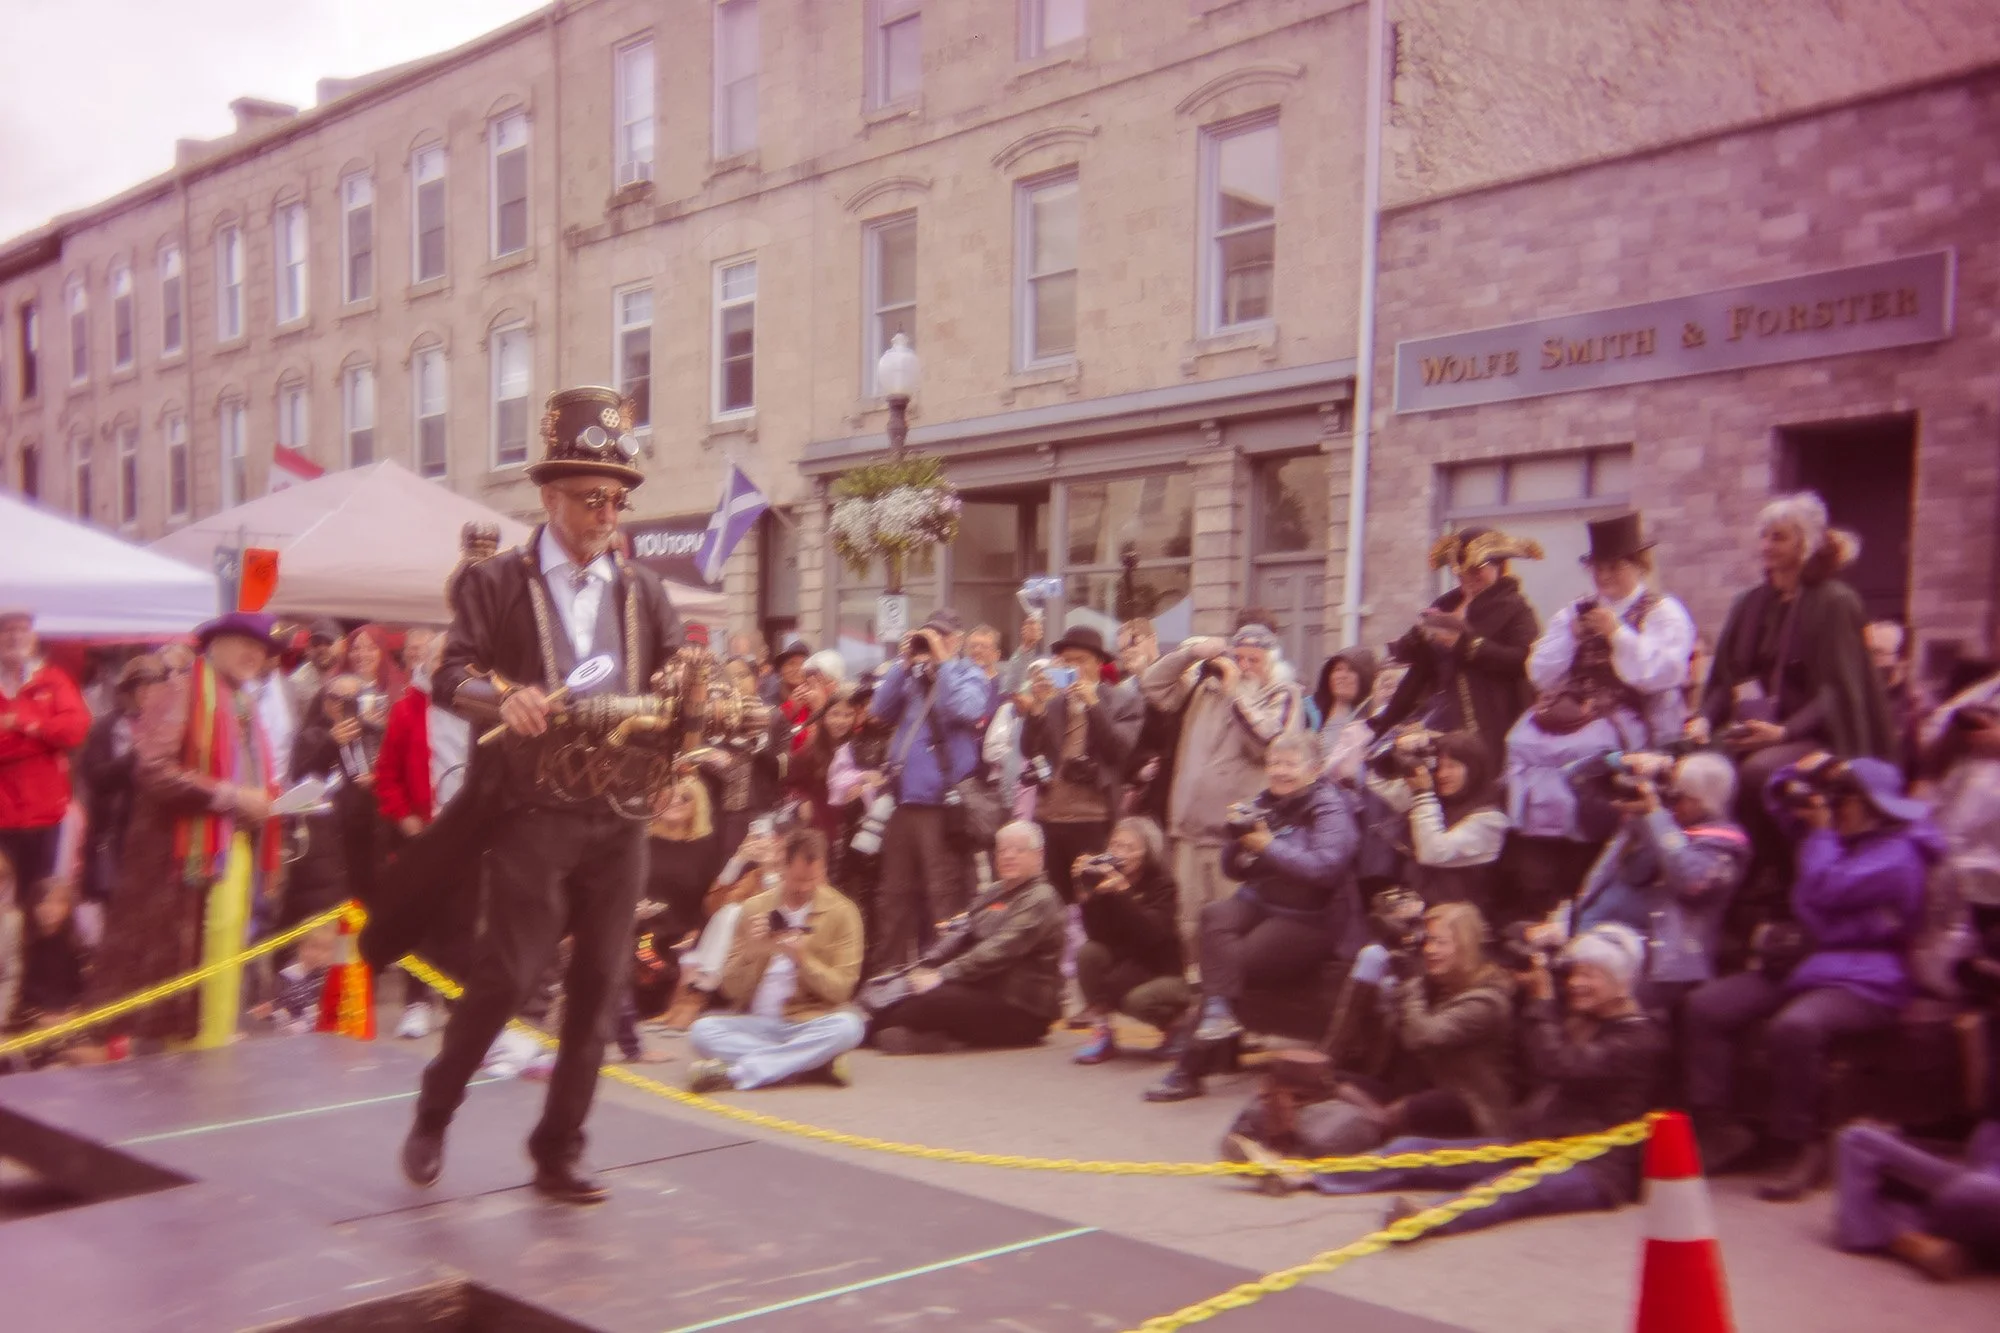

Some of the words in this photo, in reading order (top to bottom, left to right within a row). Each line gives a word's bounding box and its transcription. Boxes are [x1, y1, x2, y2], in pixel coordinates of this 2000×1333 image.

[1418, 349, 1519, 386] WOLFE
[1539, 326, 1656, 371] SMITH
[1682, 321, 1706, 349] &
[1723, 287, 1919, 342] FORSTER
